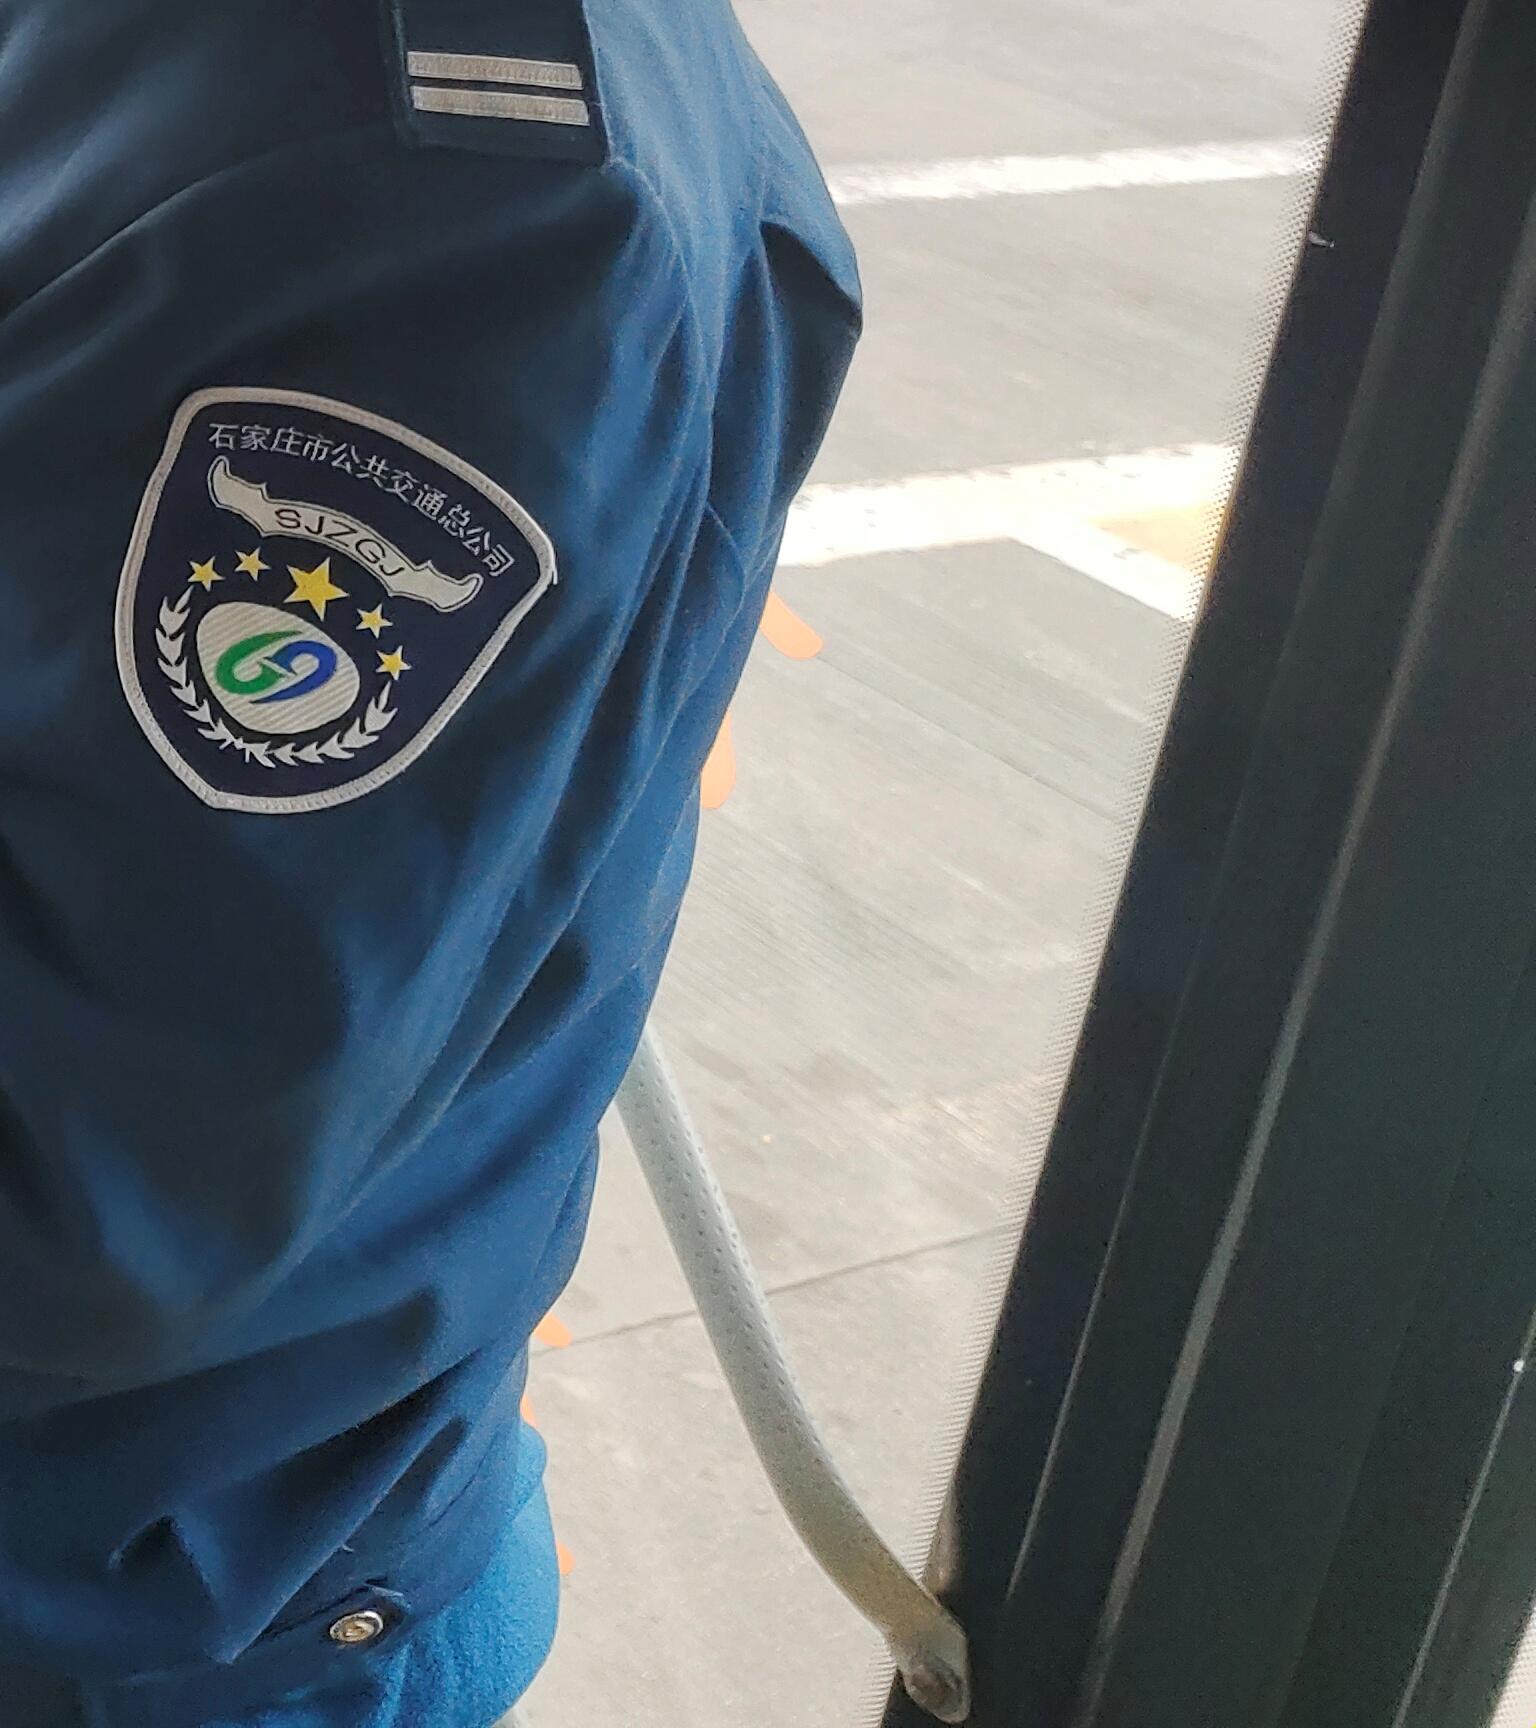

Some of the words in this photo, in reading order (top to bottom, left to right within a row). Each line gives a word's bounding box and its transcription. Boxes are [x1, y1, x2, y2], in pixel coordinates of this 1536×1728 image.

[208, 422, 516, 577] 石家庄市公共交通总公司
[274, 508, 405, 579] SJZGJ
